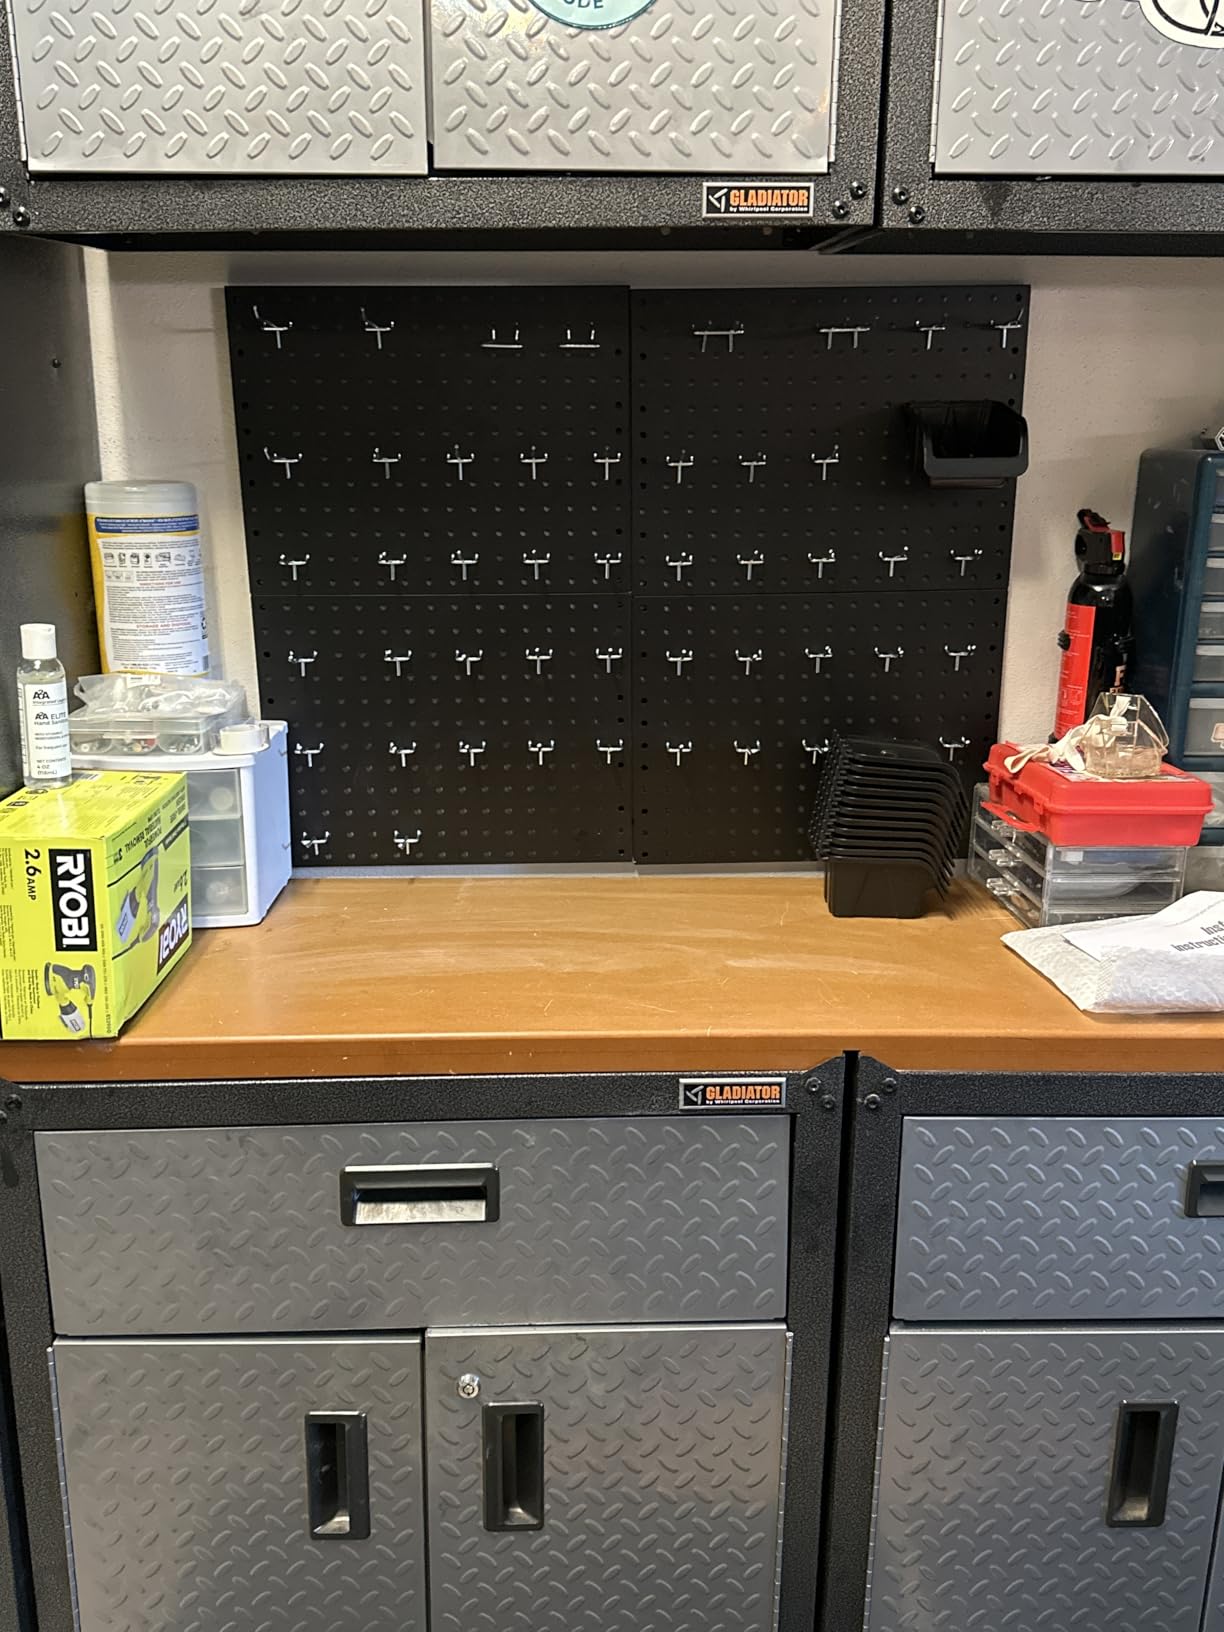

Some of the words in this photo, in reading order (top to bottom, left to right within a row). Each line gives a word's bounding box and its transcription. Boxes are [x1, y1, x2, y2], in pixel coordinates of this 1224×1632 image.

[729, 189, 809, 206] GLADIATOR
[24, 848, 42, 877] 2.6
[27, 877, 37, 901] AMP
[55, 853, 91, 946] RYOBI
[159, 902, 188, 964] RYOBI
[706, 1085, 781, 1100] GLADIATOR
